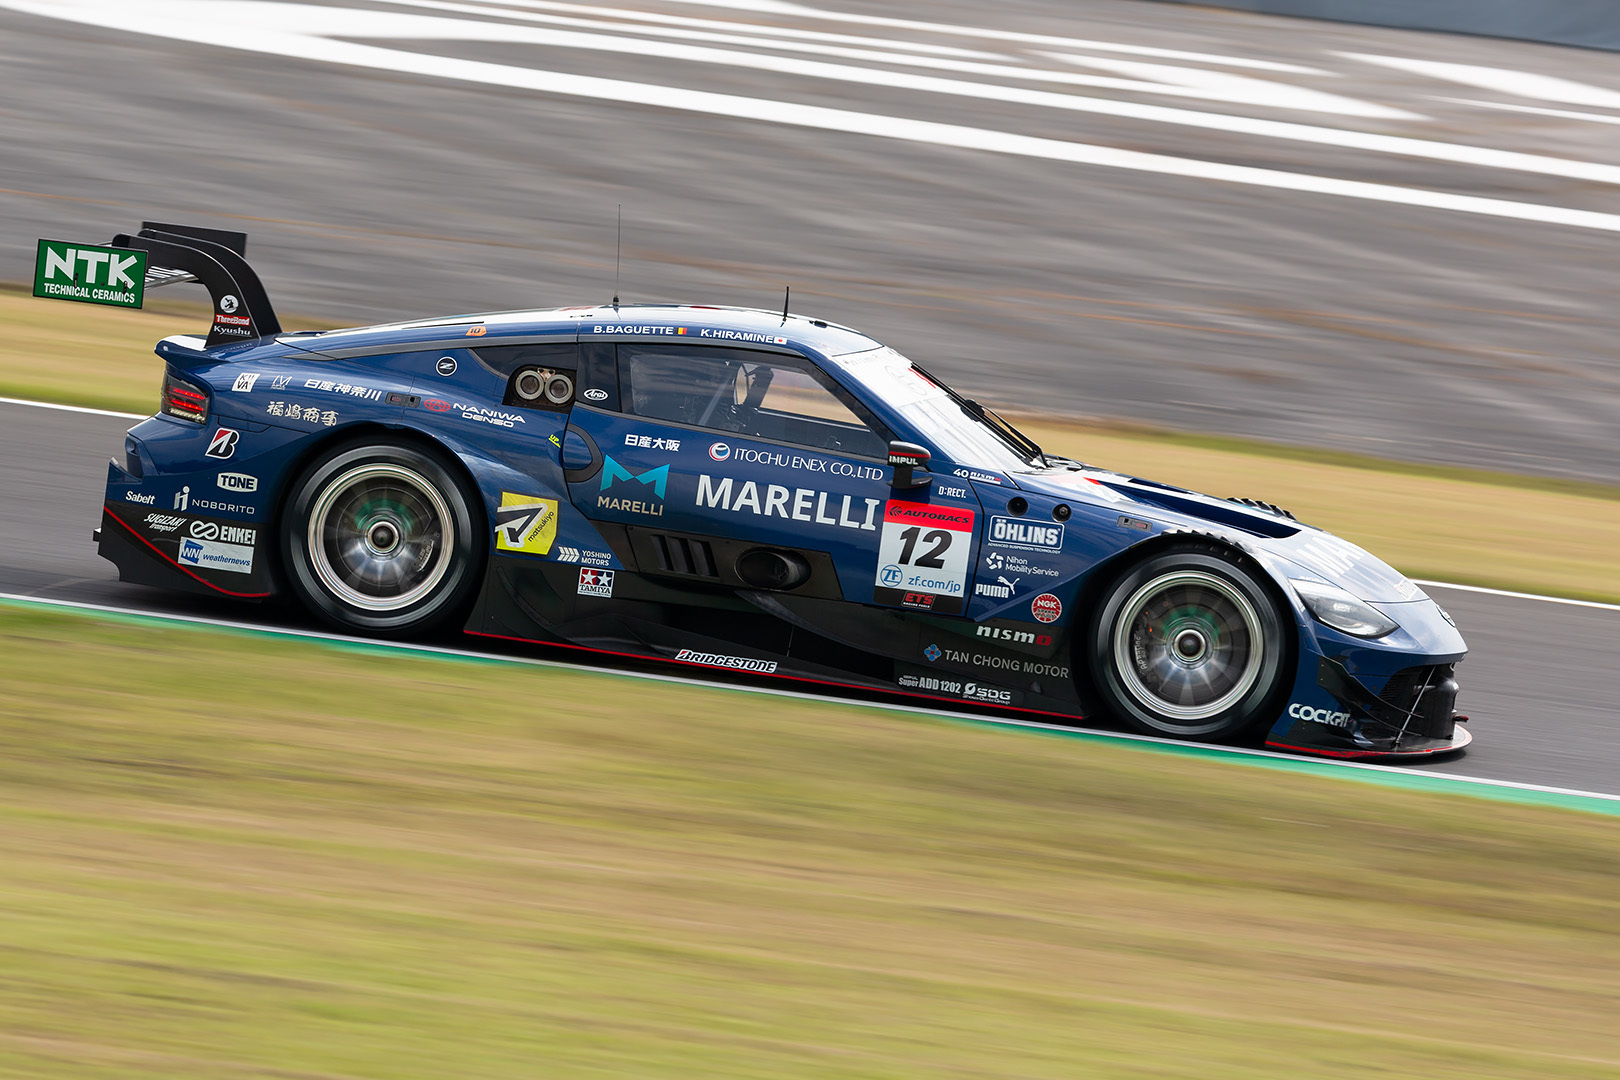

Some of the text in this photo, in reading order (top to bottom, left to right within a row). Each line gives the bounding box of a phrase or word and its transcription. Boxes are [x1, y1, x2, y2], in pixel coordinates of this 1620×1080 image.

[45, 246, 137, 289] NTK
[44, 282, 135, 304] TECHNICAL CERAMICS
[216, 315, 250, 325] ThreeBond
[214, 325, 250, 335] Kyushu
[593, 325, 673, 334] B.BAGUETTE
[700, 328, 774, 343] K.HIRAMINE
[304, 378, 382, 402] 日産神奈川
[452, 402, 525, 424] NANIWA
[461, 412, 515, 428] DENSO
[624, 434, 681, 453] 日産大阪
[734, 447, 790, 468] ITOCHU
[792, 456, 828, 473] ENEX
[888, 455, 918, 466] IMPUL
[220, 474, 255, 490] TONE
[953, 468, 1002, 482] 40 nismo
[125, 490, 155, 505] Sabelt
[597, 495, 663, 516] MARELLI
[695, 474, 881, 531] MARELLI
[192, 499, 255, 515] NOBORITO
[144, 513, 187, 527] SUGIZAKI
[903, 508, 970, 524] AUTOBACS
[527, 510, 555, 542] matsukiyo
[994, 518, 1060, 545] ÖHLINS
[220, 525, 256, 545] ENKEI
[581, 549, 612, 560] YOSHINO
[898, 526, 953, 569] 12
[203, 552, 250, 566] weathernews
[581, 557, 610, 567] MOTORS
[1006, 555, 1028, 565] Nihon
[580, 584, 610, 594] TAMIYA
[908, 576, 961, 593] zf.com/jp
[975, 583, 1009, 599] PUMA
[905, 592, 934, 605] ETS
[1037, 599, 1057, 609] NGK
[976, 625, 1052, 646] nismo
[675, 649, 778, 673] BRIDGESTONE
[945, 649, 1069, 678] TAN CHONG MOTOR
[898, 677, 961, 694] Super ADD 1202
[976, 688, 1011, 701] SDG
